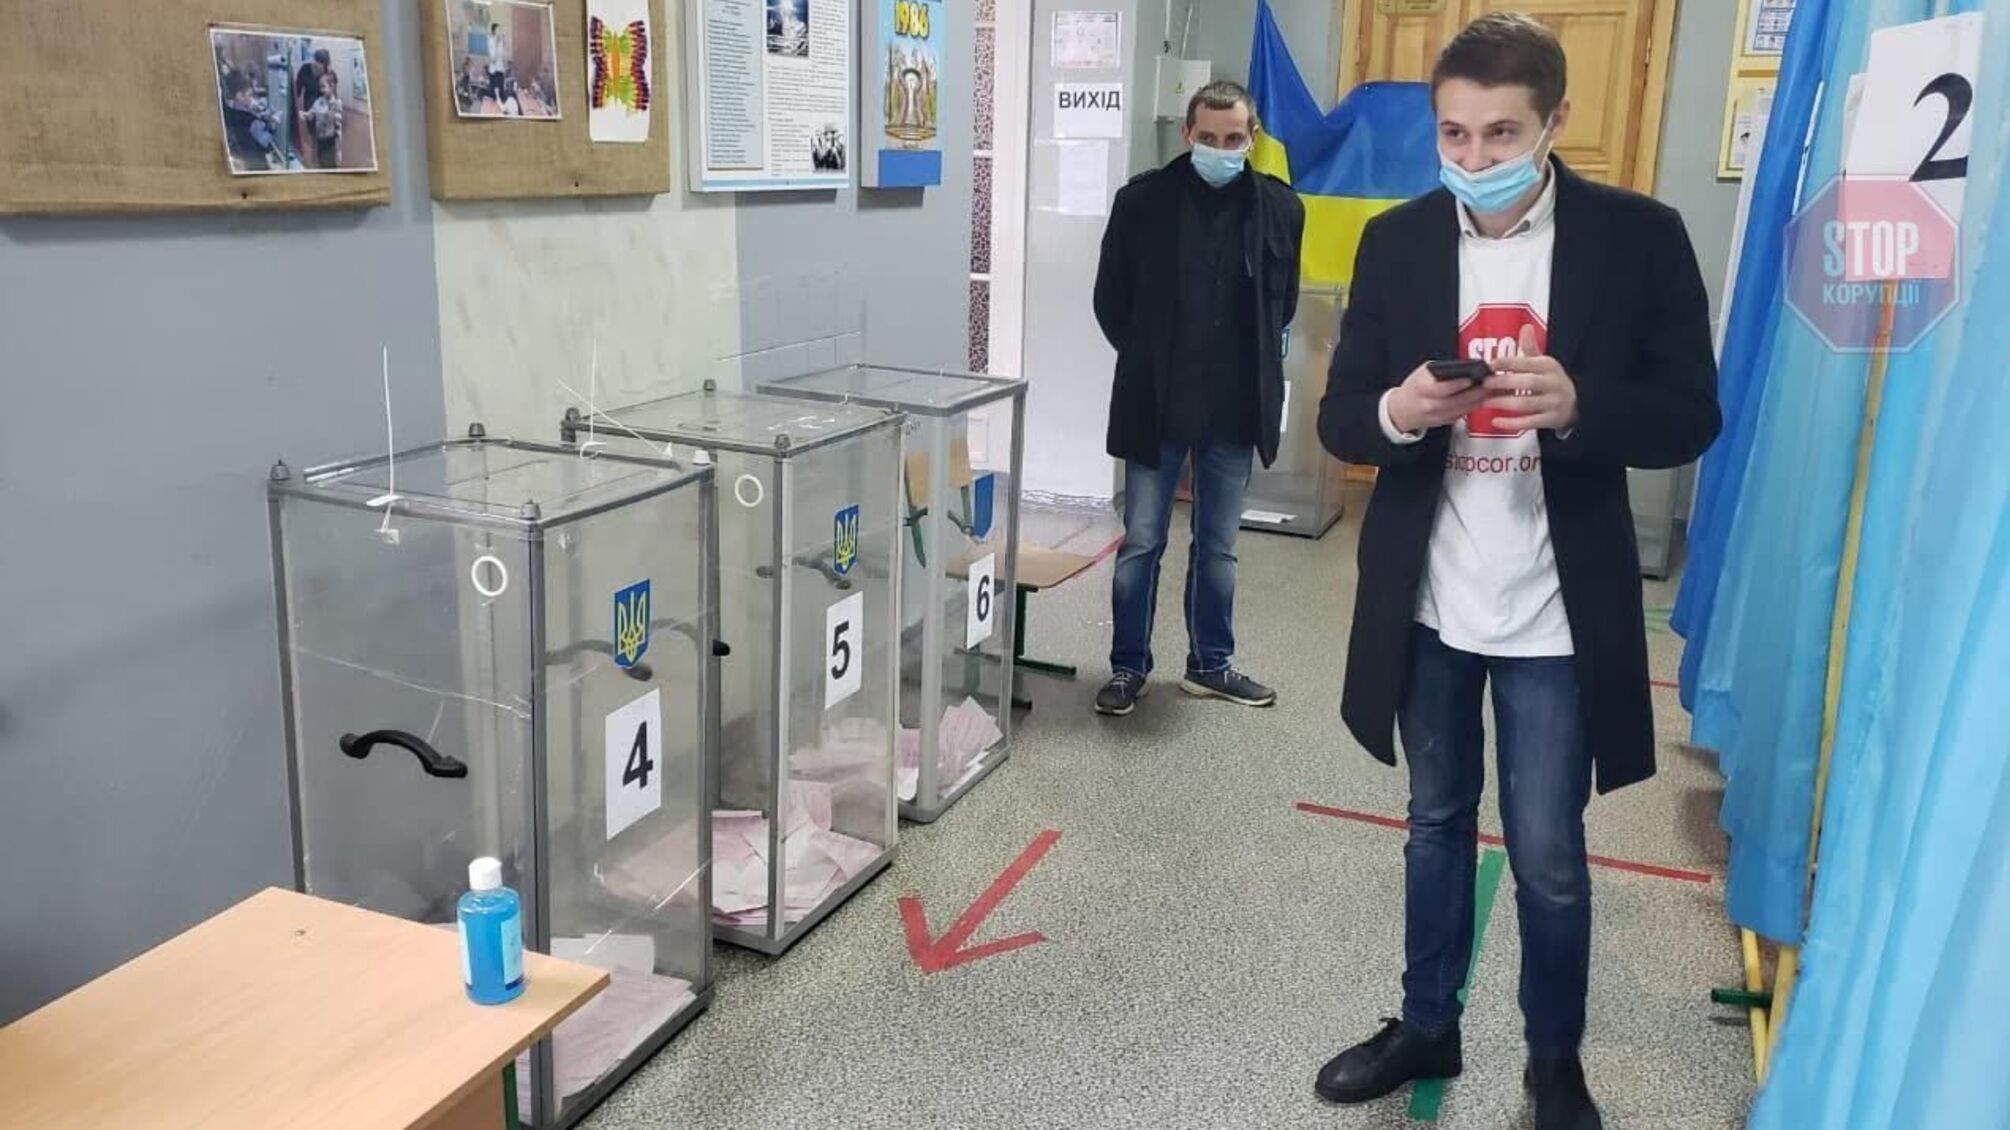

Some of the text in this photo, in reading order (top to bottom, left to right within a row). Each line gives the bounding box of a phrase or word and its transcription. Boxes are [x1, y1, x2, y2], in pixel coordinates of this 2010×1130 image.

[895, 0, 930, 40] 1986
[1058, 91, 1121, 111] ВИХІД
[1909, 72, 1973, 182] 2
[1468, 337, 1526, 368] STO
[976, 574, 991, 623] 6
[831, 620, 851, 681] 5
[622, 721, 654, 790] 4
